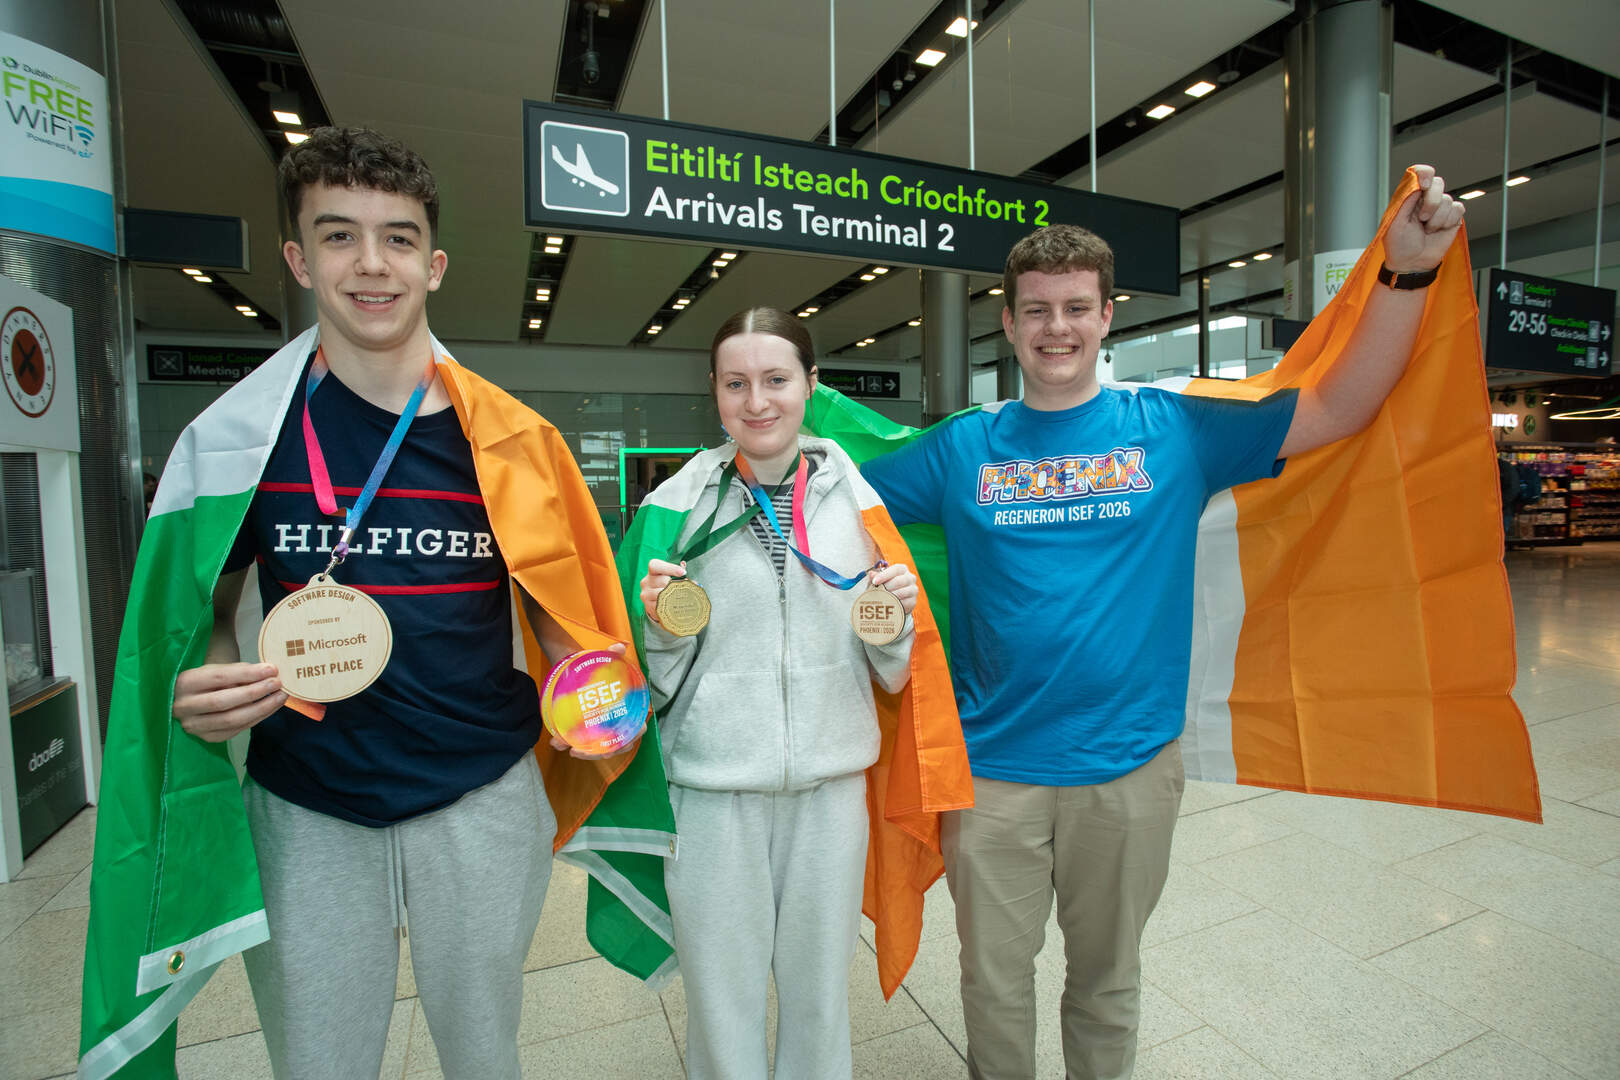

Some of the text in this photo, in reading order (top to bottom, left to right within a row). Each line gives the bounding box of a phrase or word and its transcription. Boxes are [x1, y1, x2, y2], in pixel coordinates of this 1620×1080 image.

[3, 71, 95, 127] FREE
[5, 99, 73, 142] WiFi
[646, 139, 1050, 227] Eitiltí Isteach Críochfort 2
[645, 186, 956, 252] Arrivals Terminal 2
[1508, 310, 1548, 335] 29-56
[188, 365, 240, 378] Meeting
[857, 375, 865, 392] 1
[977, 447, 1153, 506] PHOENIX
[994, 501, 1131, 526] REGENERON ISEF 2026
[273, 523, 493, 558] HILFIGER
[287, 589, 356, 610] SOFTWARE DESIGN
[859, 605, 895, 620] ISEF
[308, 633, 368, 651] Microsoft
[296, 659, 364, 679] FIRST PLACE
[577, 680, 622, 711] ISEF
[584, 711, 611, 729] PHOENIX
[612, 706, 628, 720] 2026
